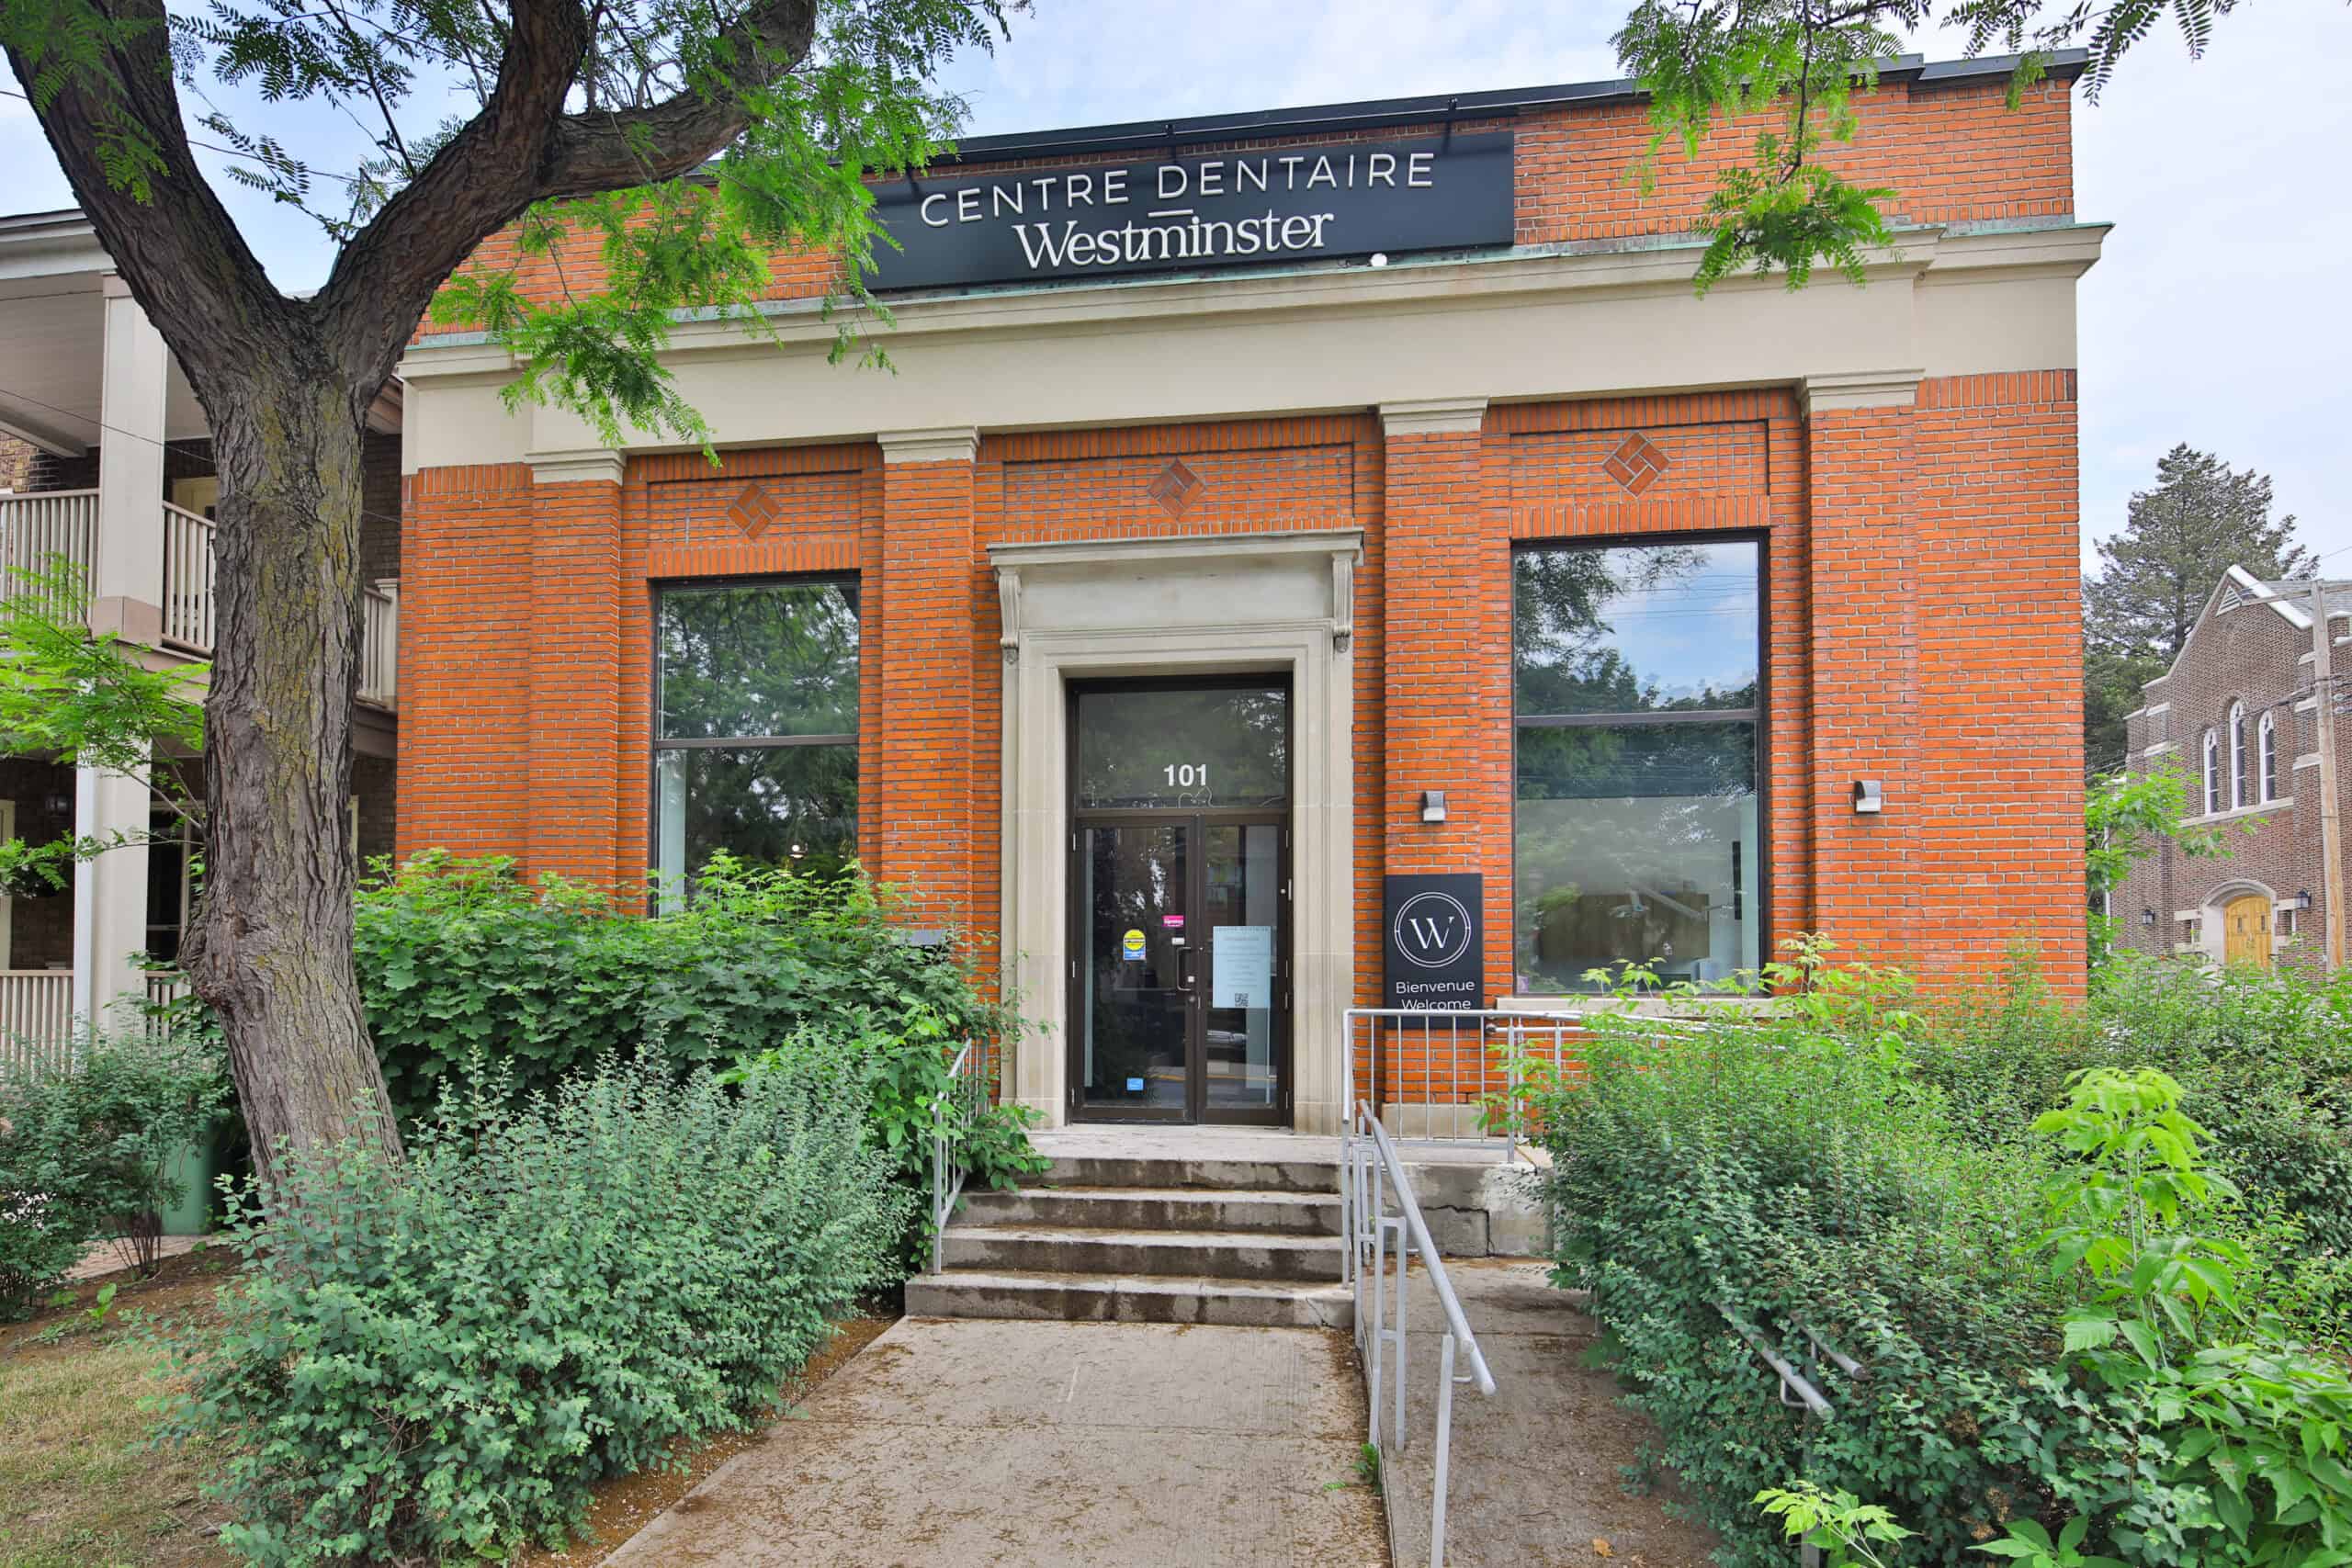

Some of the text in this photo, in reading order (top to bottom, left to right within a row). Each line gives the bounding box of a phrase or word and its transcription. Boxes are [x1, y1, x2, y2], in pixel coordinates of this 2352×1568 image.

[921, 152, 1434, 228] CENTRE DENTAIRE
[1012, 210, 1334, 269] Westminster
[1163, 763, 1206, 787] 101
[1408, 916, 1455, 949] W
[1396, 981, 1476, 994] Bienvenue
[1401, 998, 1472, 1010] Welcome
